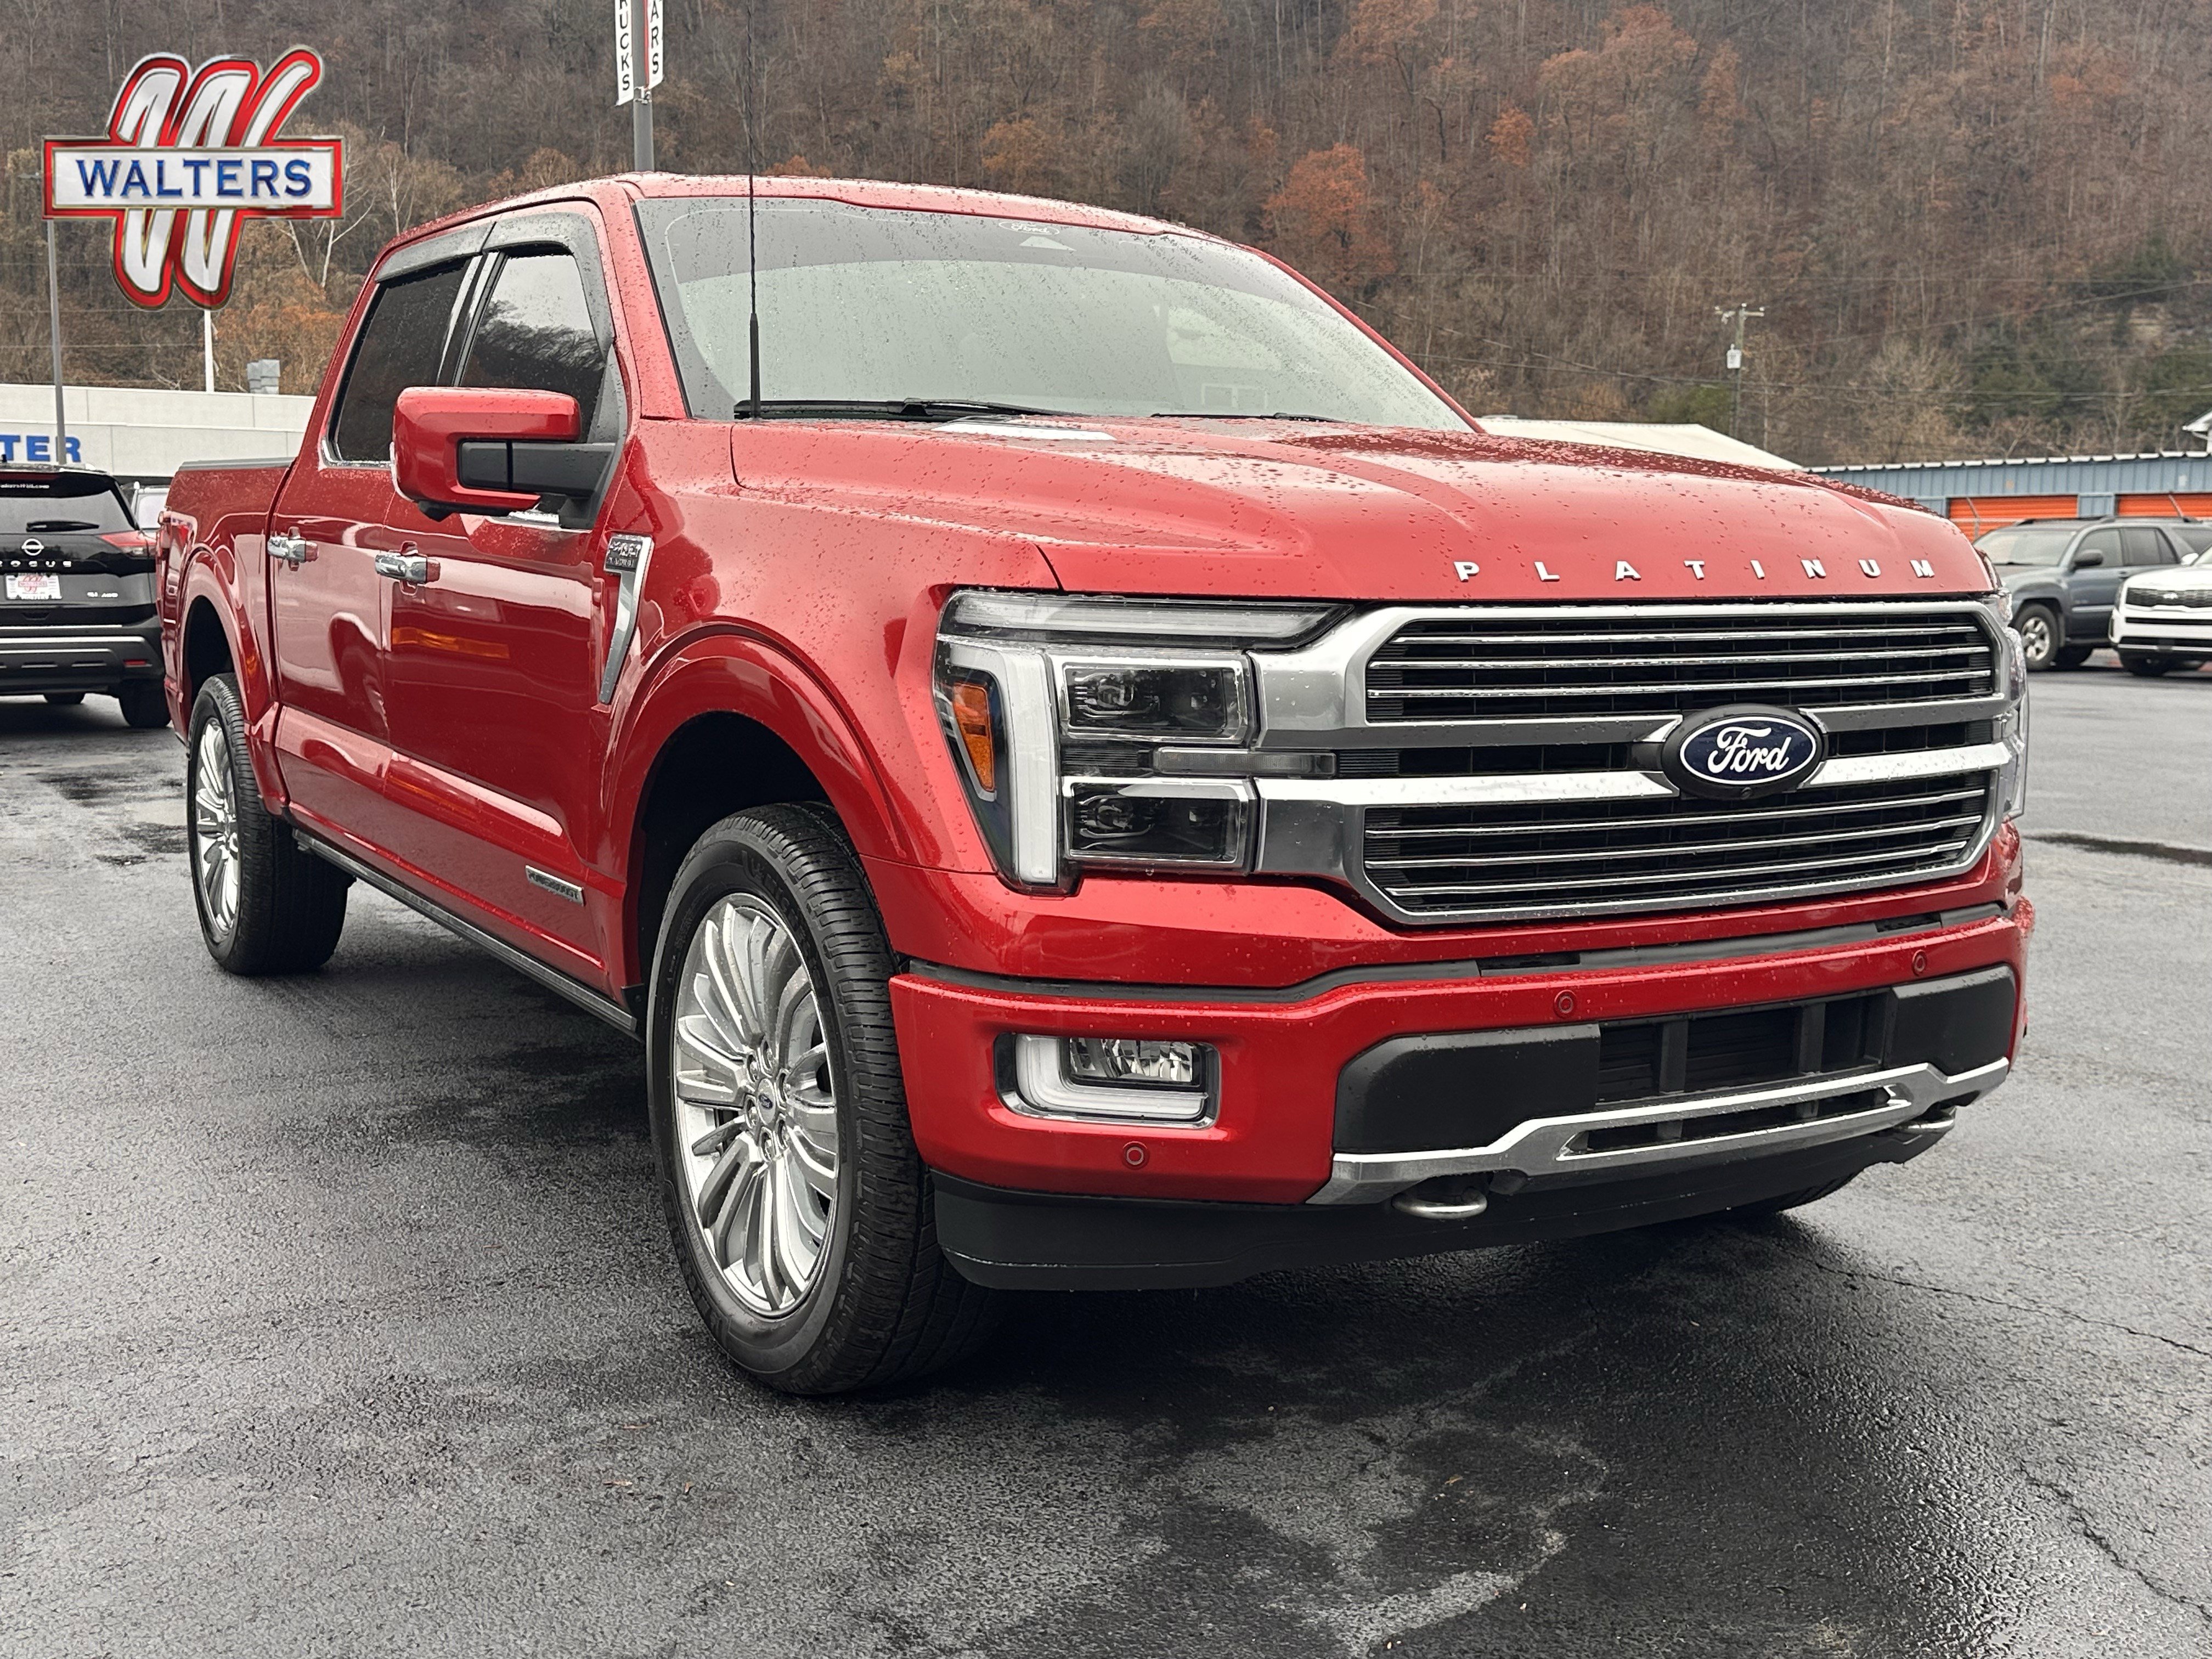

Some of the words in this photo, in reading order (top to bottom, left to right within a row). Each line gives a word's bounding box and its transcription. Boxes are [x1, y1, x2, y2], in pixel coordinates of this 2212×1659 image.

[650, 0, 661, 75] ARS
[0, 434, 81, 462] TER
[1453, 558, 1936, 583] PLATINUM
[1707, 726, 1792, 774] Ford
